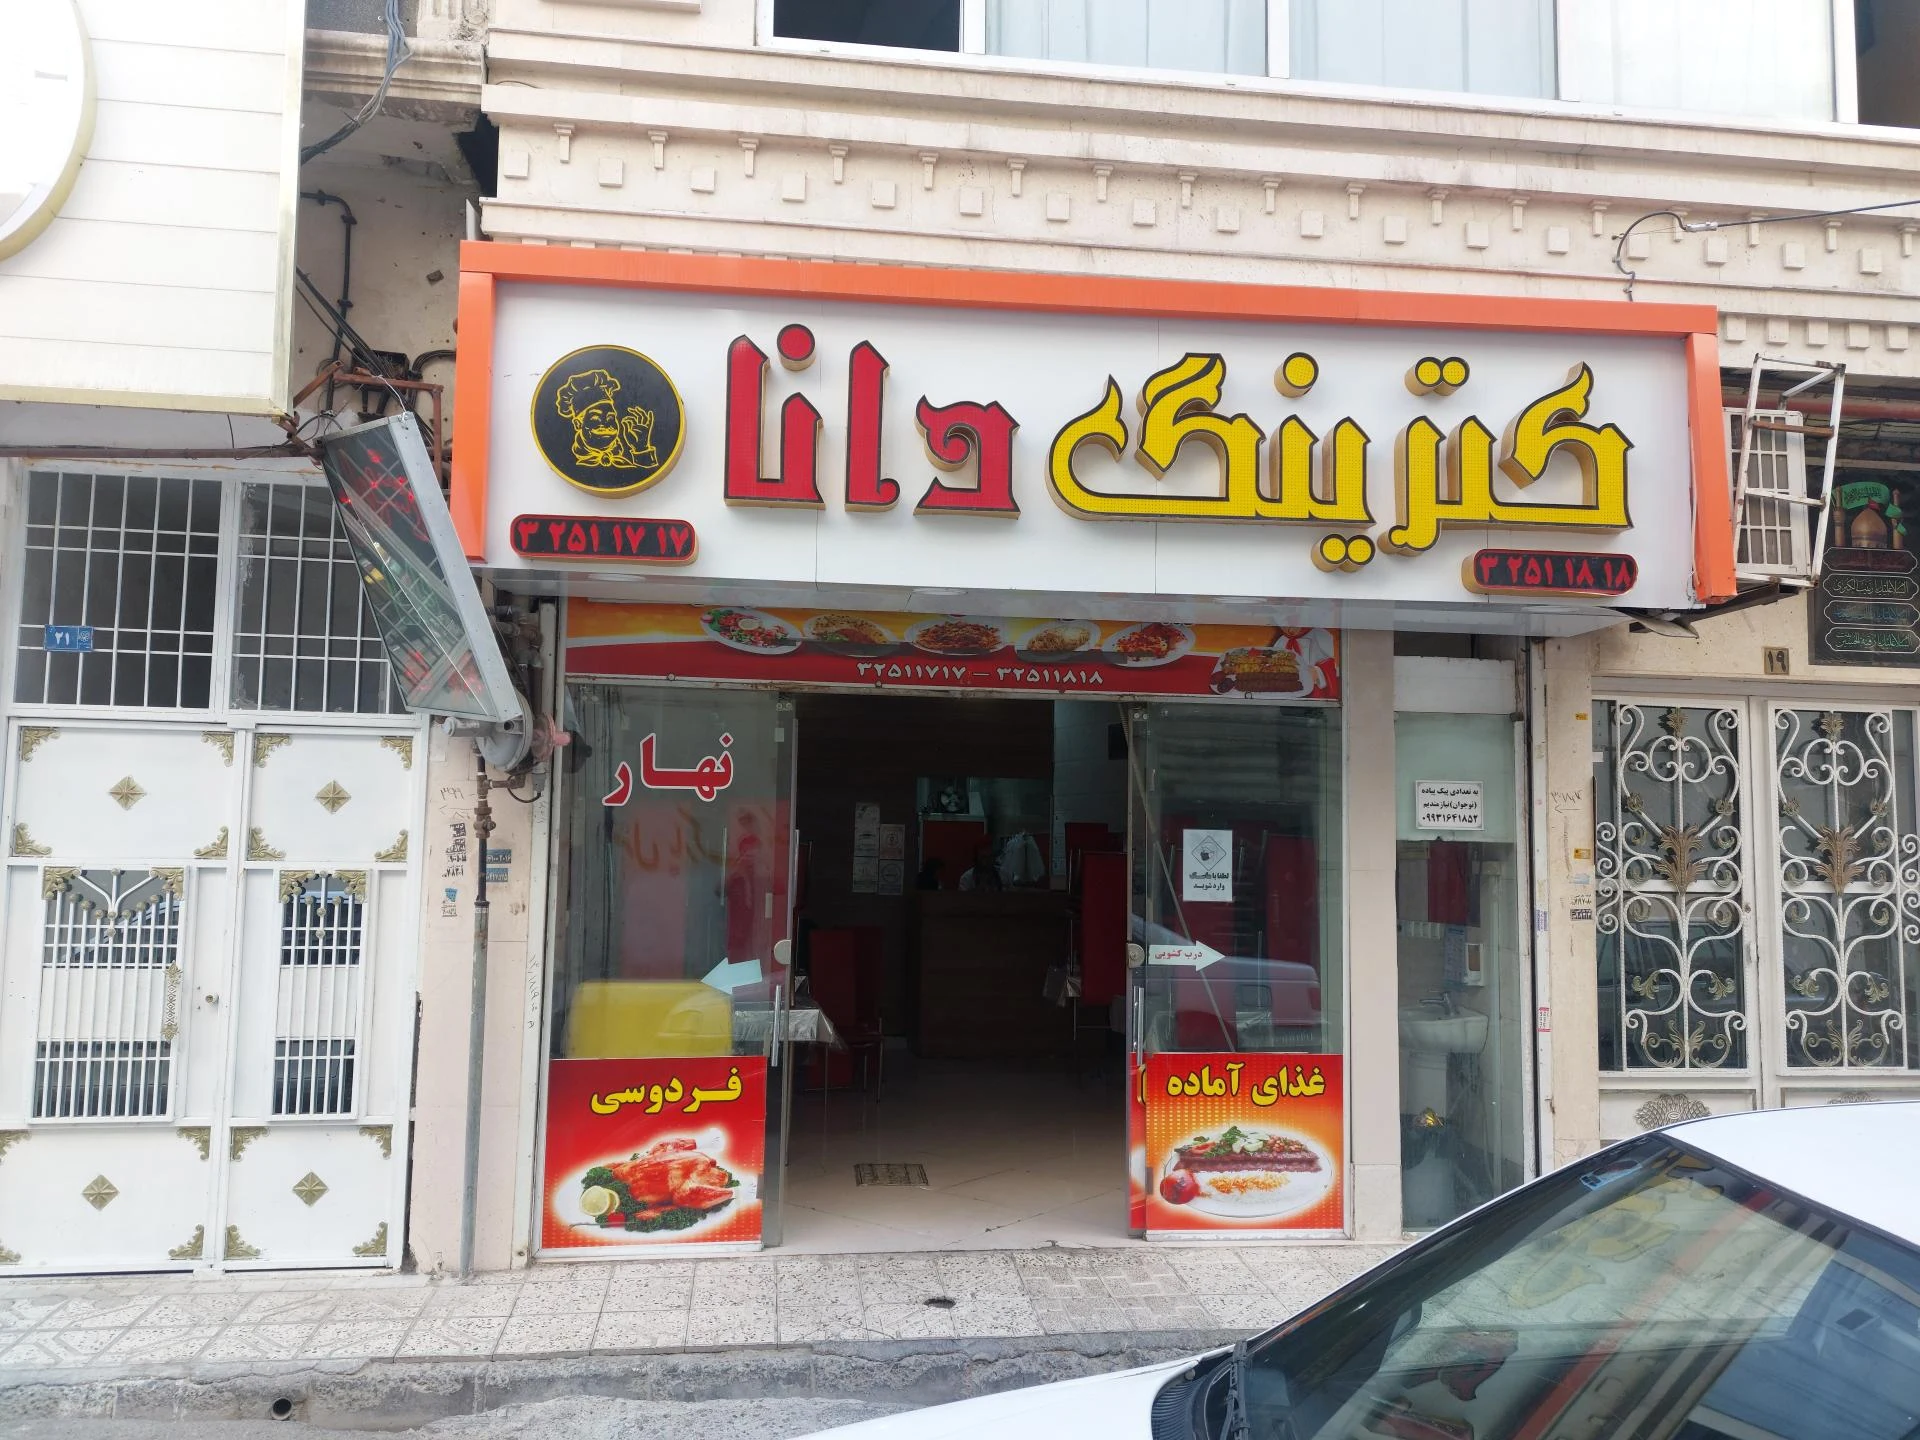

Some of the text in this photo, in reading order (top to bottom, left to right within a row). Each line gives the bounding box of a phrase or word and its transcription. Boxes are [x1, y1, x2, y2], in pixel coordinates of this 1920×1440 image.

[724, 323, 1635, 573] کترینگ دانا
[54, 631, 71, 647] ۲۱
[856, 661, 967, 681] ۳۲۵۱۱۷۱۷
[996, 666, 1104, 685] ۳۲۵۱۱۸۱۸
[1767, 650, 1787, 673] ۱۹
[601, 732, 734, 806] نهار
[1184, 950, 1203, 960] درب
[590, 1066, 744, 1116] فردوسی
[1166, 1062, 1246, 1098] آماده
[1250, 1064, 1327, 1107] غذای
